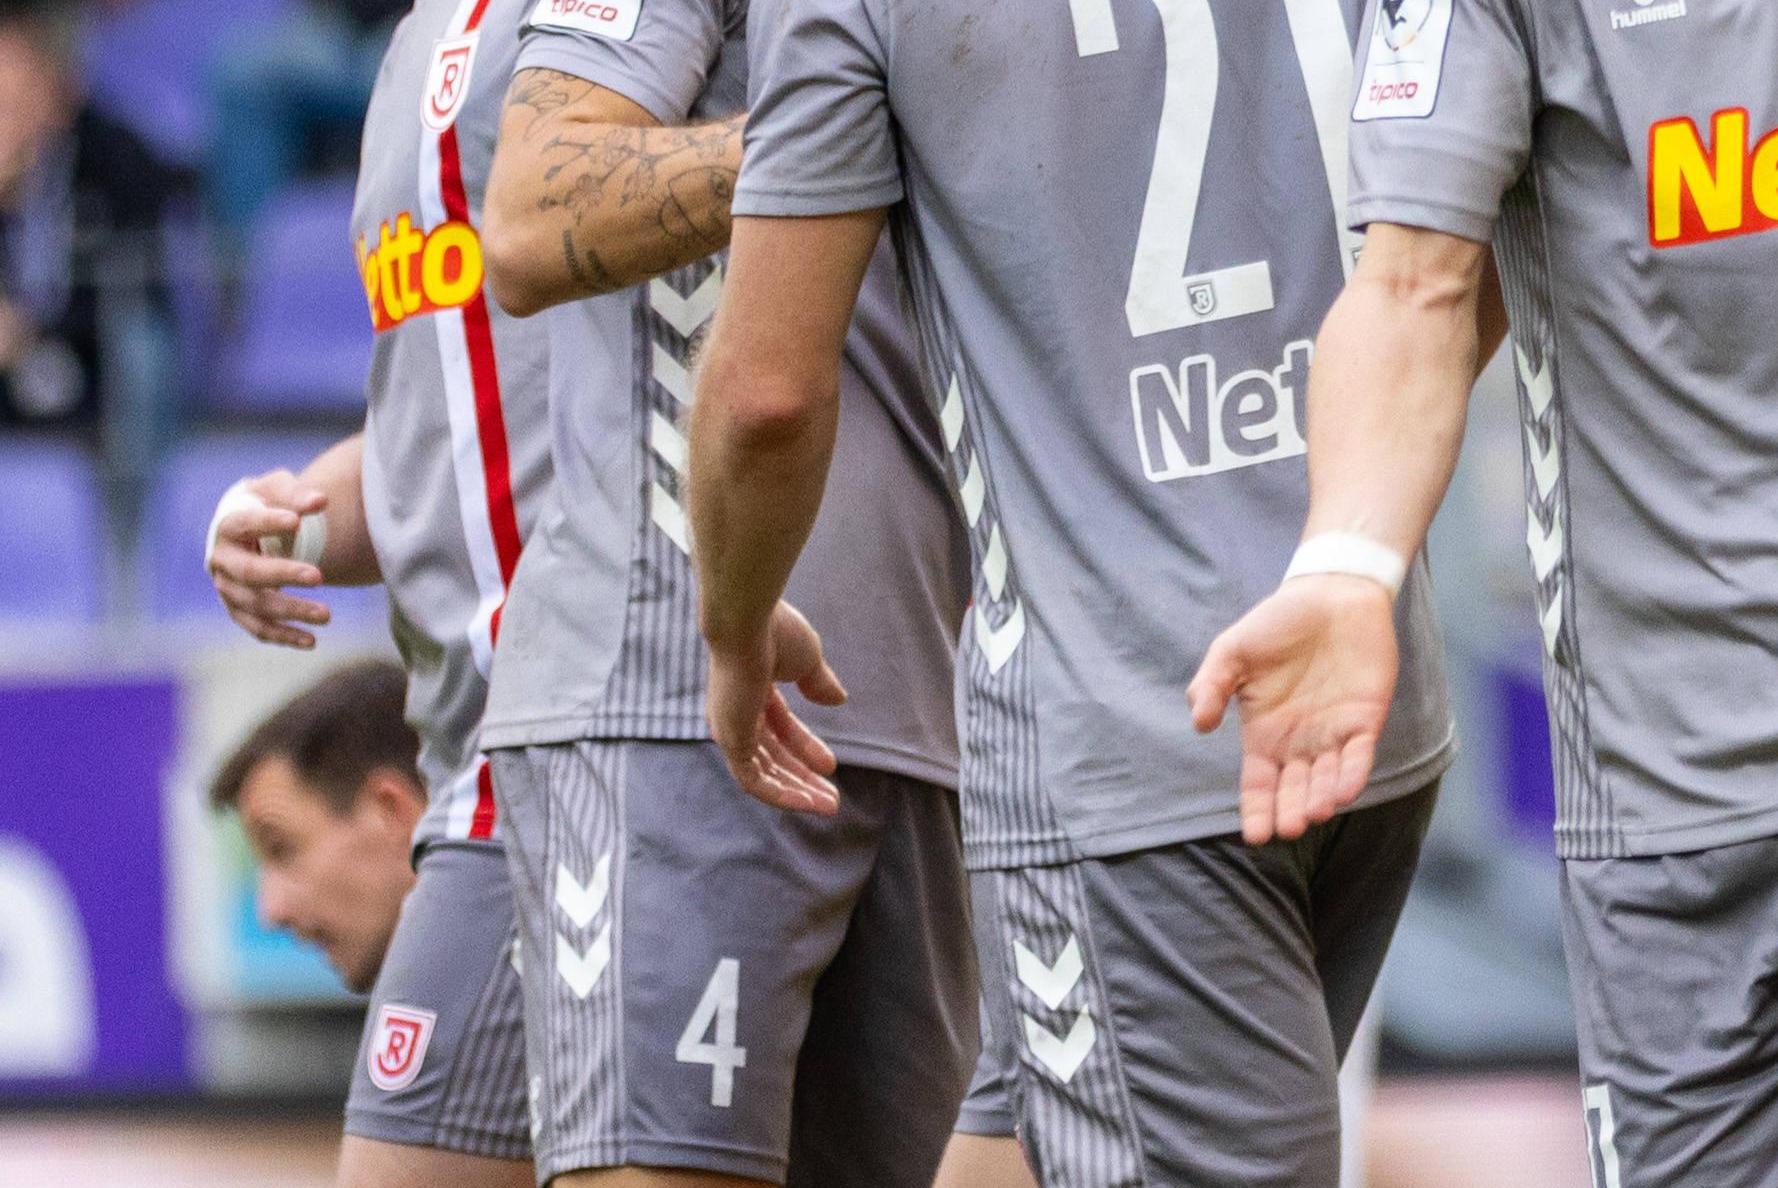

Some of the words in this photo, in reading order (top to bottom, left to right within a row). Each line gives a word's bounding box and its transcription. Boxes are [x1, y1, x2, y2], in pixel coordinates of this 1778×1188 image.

[1369, 79, 1419, 106] tipico
[354, 211, 485, 334] etto
[1129, 339, 1315, 482] Net
[675, 957, 747, 1107] 4
